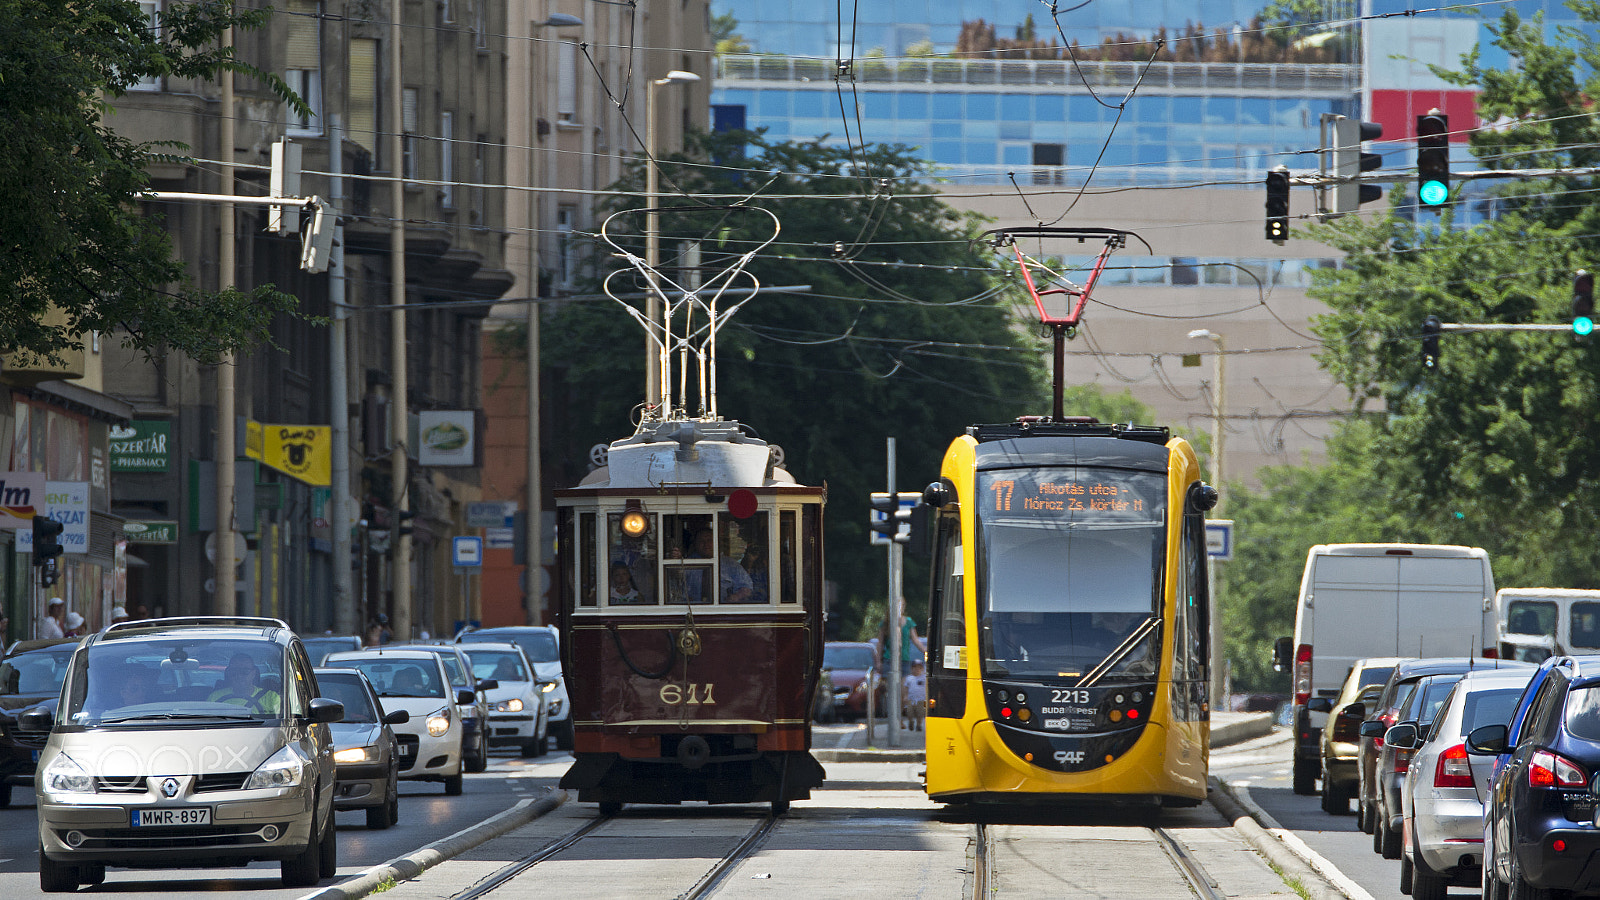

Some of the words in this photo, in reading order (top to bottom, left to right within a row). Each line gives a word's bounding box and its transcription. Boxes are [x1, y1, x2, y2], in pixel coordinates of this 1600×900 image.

[118, 457, 167, 467] PHARMACY
[990, 480, 1015, 511] 17
[1039, 483, 1085, 496] Alkotás
[1089, 483, 1118, 496] utca
[1024, 496, 1064, 511] Móricz
[1067, 498, 1087, 511] Zs.
[1090, 498, 1130, 511] körtér
[1133, 499, 1143, 511] M
[660, 683, 716, 705] 611
[1051, 689, 1090, 704] 2213
[142, 809, 207, 825] MWR-897
